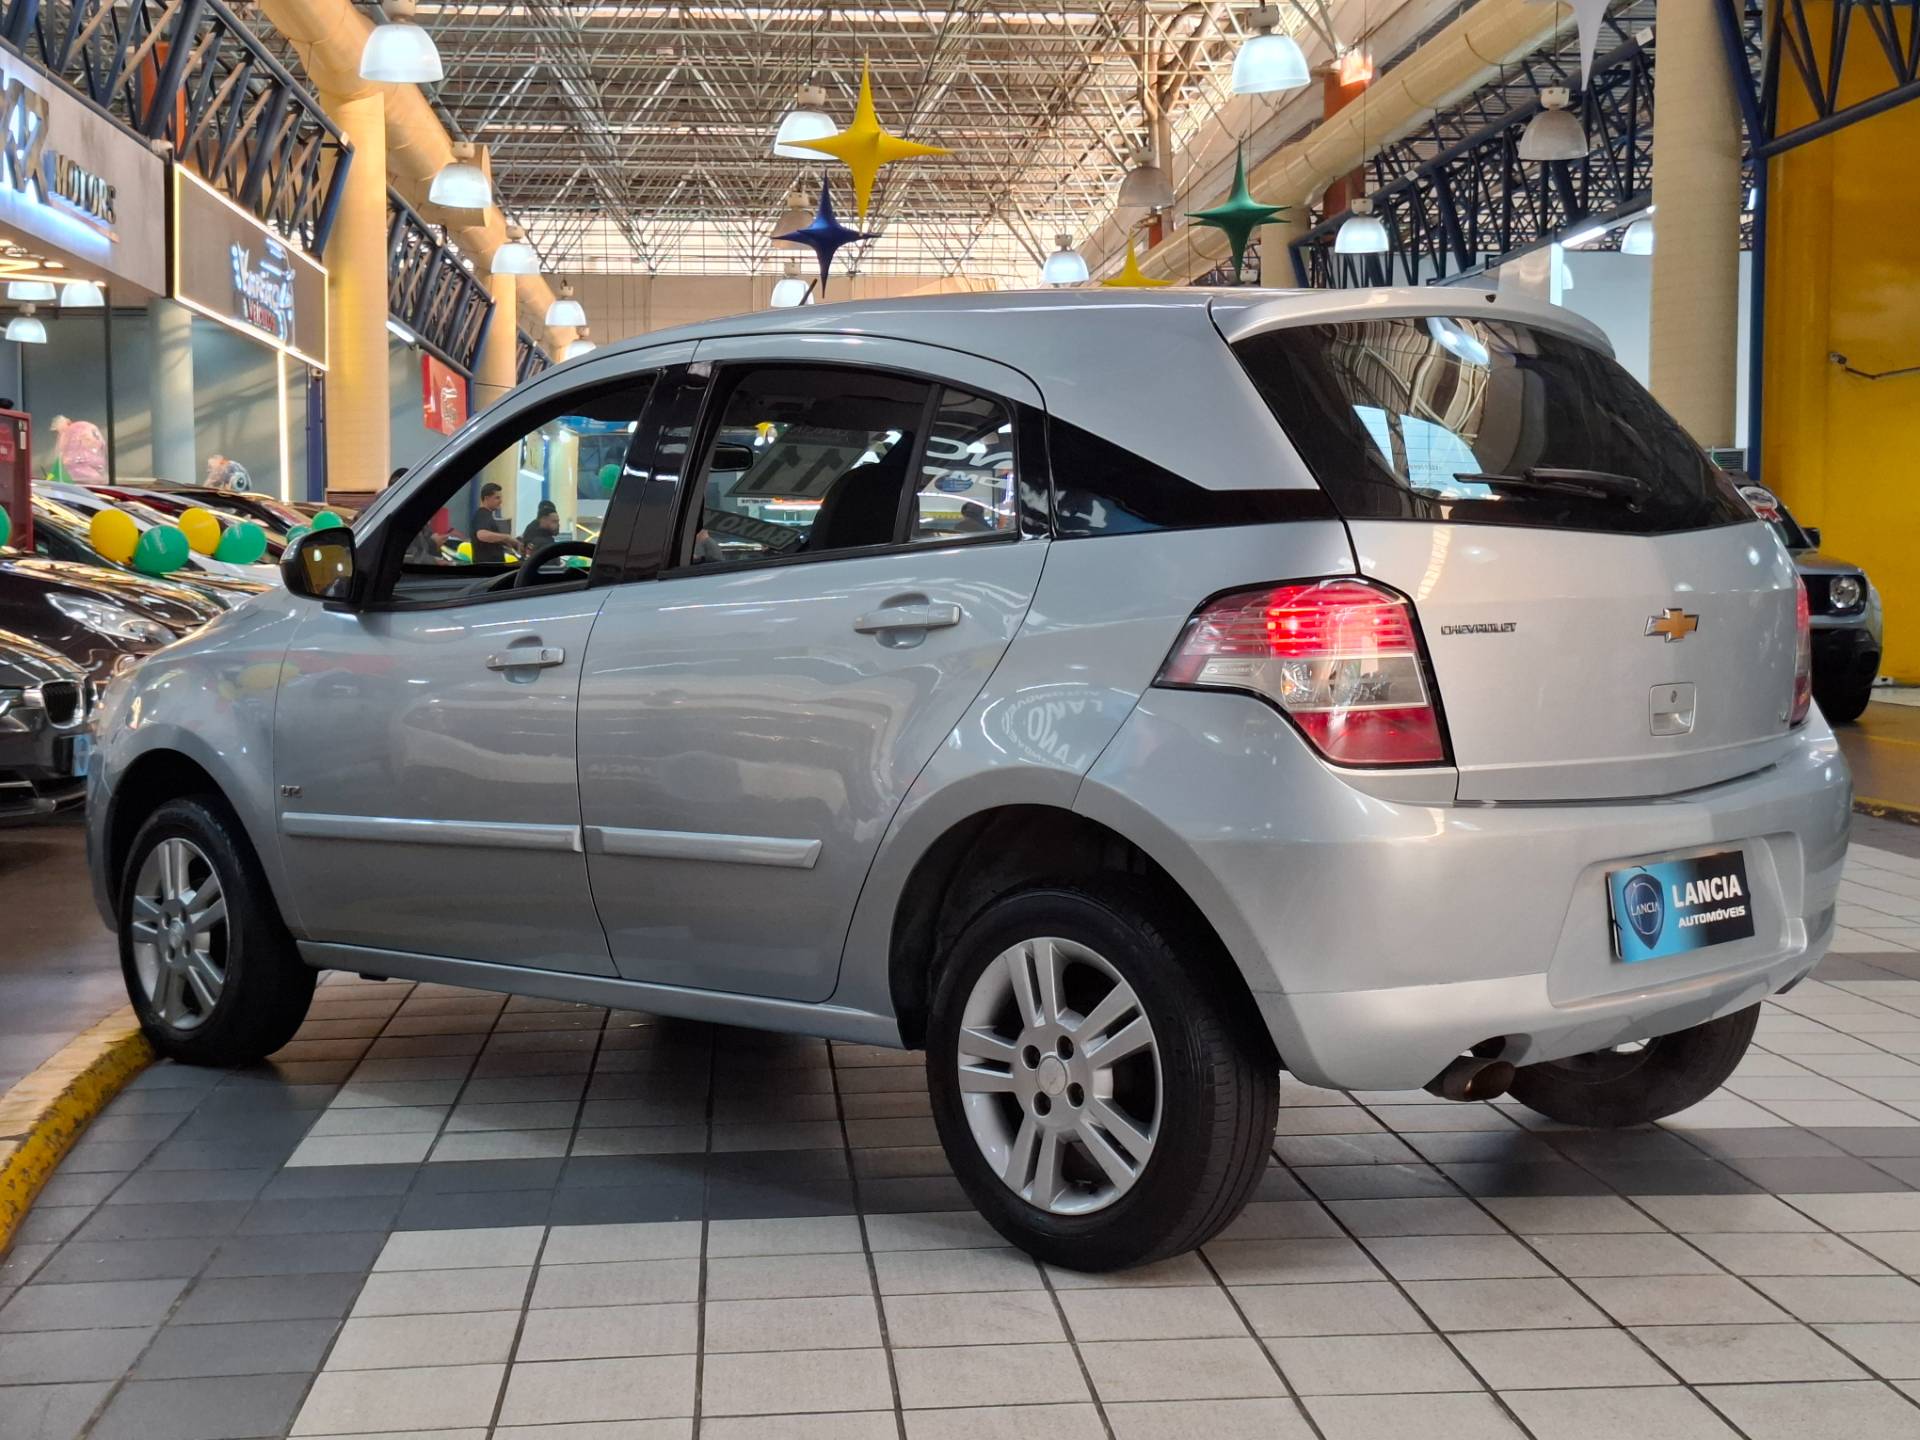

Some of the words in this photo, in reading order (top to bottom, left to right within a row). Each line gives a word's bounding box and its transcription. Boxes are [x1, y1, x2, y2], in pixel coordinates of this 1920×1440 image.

[55, 154, 116, 224] MOTORS
[1441, 622, 1517, 636] CHEVROLET
[1671, 873, 1743, 908] LANCIA
[1630, 901, 1661, 916] LANCIA
[1678, 905, 1746, 928] AUTOMÓVEIS
